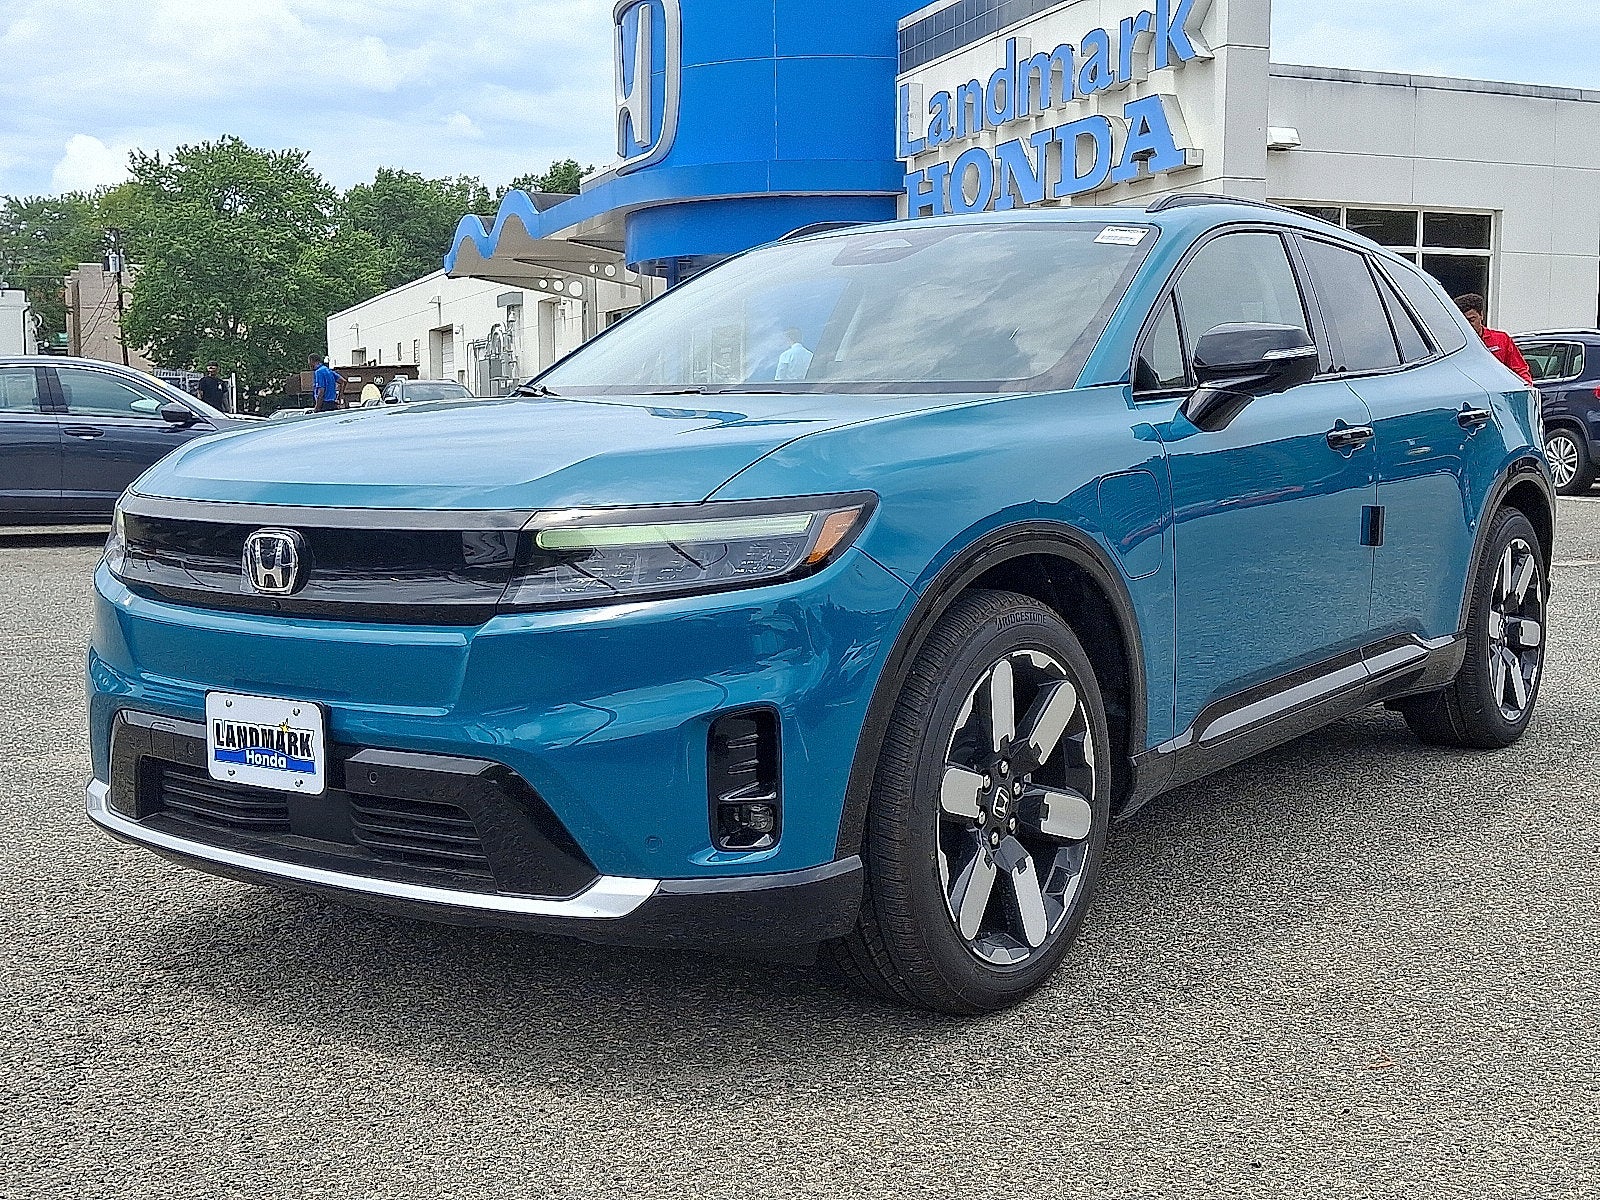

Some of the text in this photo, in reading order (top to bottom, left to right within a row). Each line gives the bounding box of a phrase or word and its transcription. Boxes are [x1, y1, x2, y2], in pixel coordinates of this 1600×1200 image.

[899, 0, 1197, 158] Landmark
[903, 93, 1187, 219] HONDA
[995, 610, 1048, 632] BRIDGESTONE
[214, 721, 312, 759] LANDMARK
[245, 749, 288, 769] Honda
